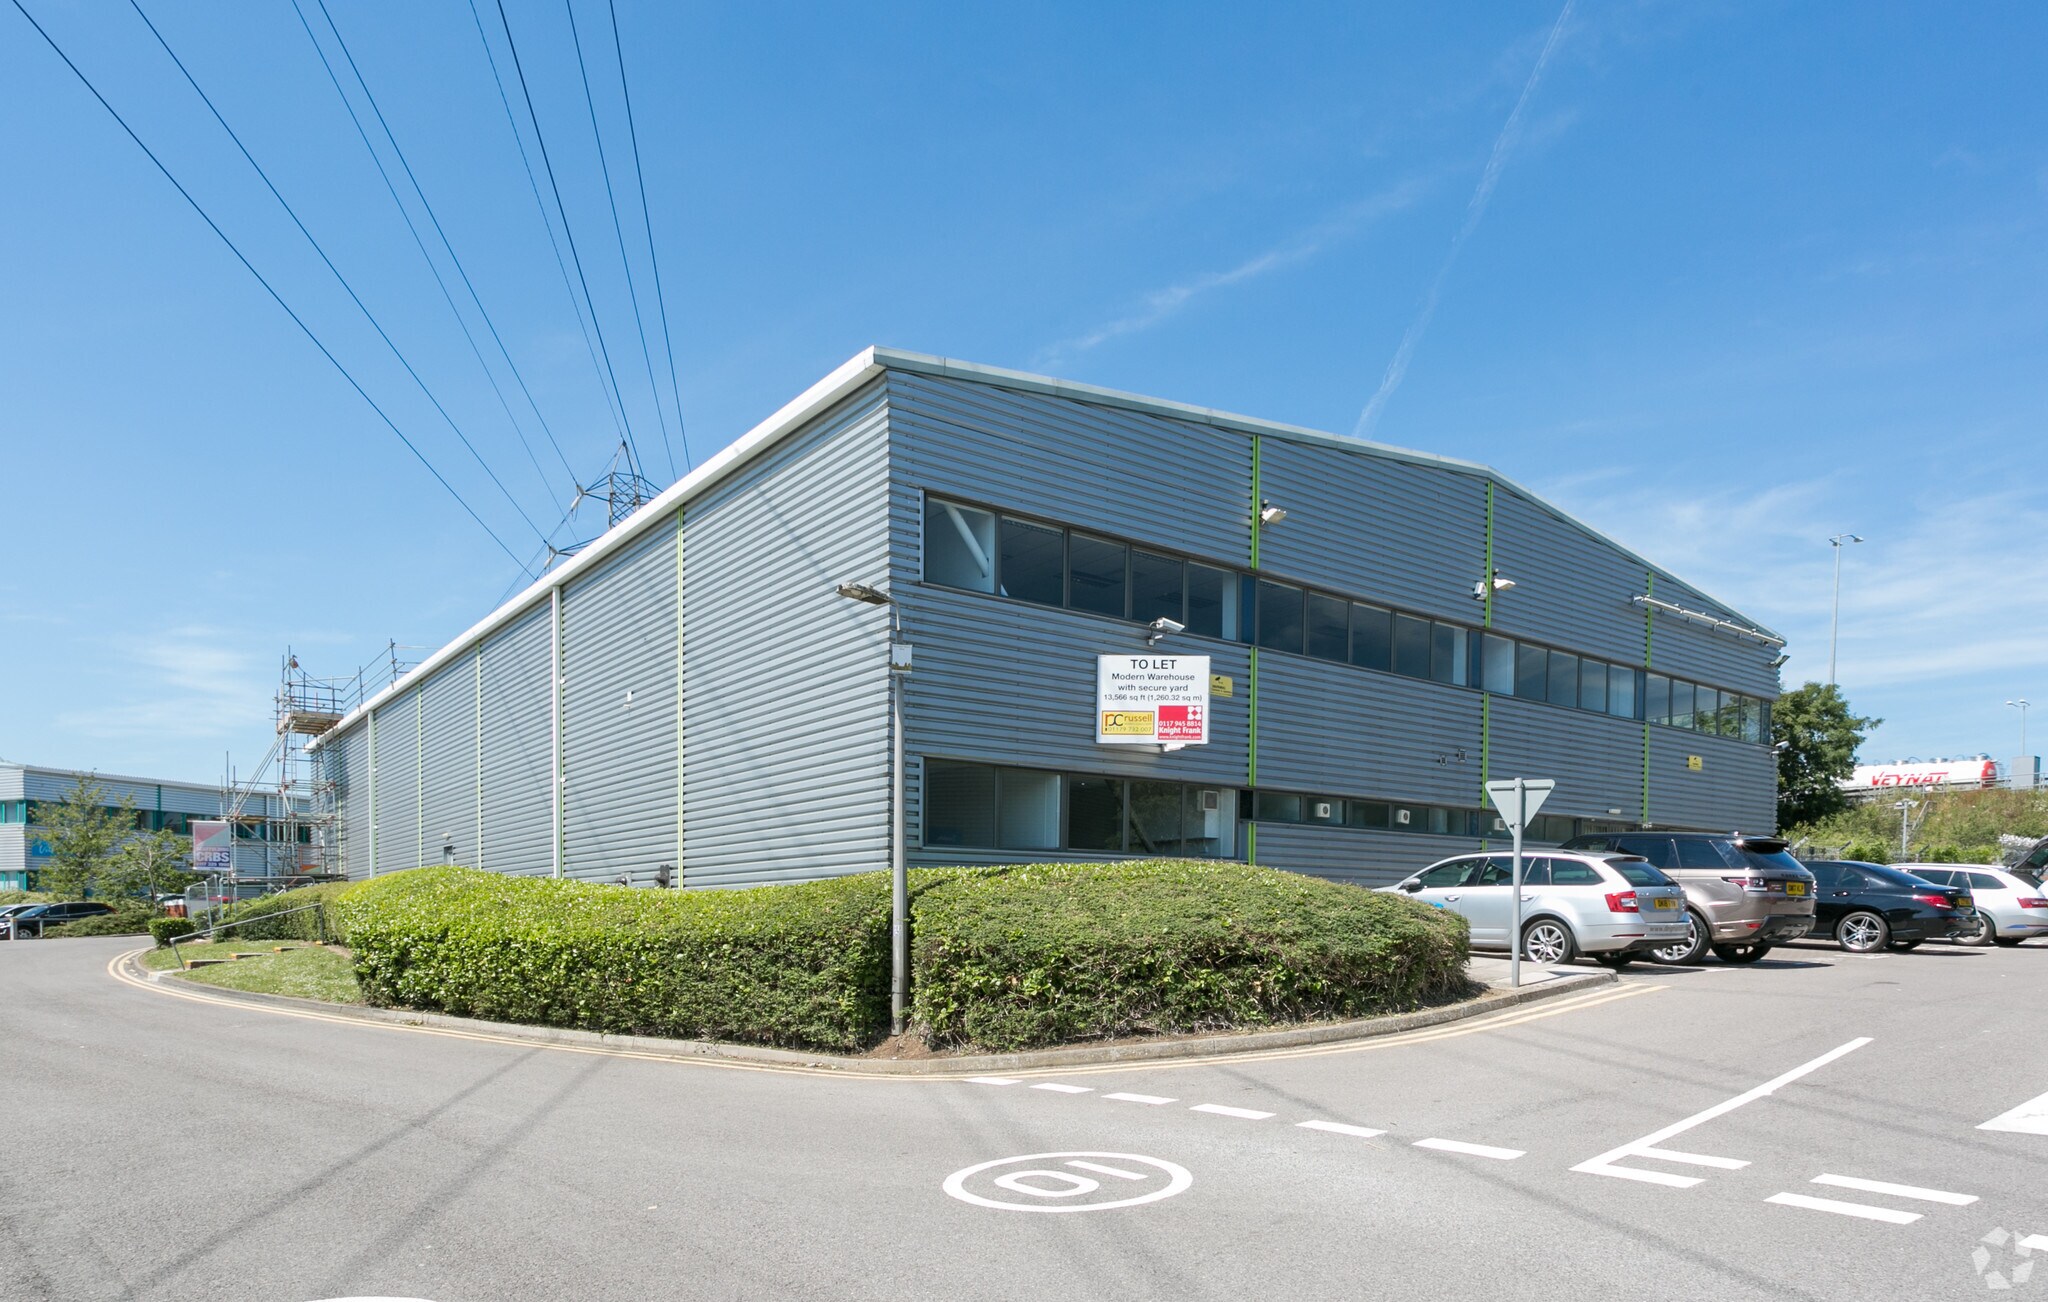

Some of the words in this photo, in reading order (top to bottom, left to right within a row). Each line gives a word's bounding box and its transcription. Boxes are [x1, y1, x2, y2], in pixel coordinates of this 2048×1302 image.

[1130, 659, 1149, 670] TO
[1153, 659, 1177, 670] LET
[1147, 673, 1195, 681] Warehouse
[1169, 684, 1188, 693] yard
[1147, 694, 1180, 702] (1,260.32
[1192, 694, 1203, 702] m)
[1124, 714, 1152, 722] russell
[1158, 727, 1181, 735] Knight
[1871, 771, 1949, 786] VEYNAT
[196, 851, 230, 862] CRBS
